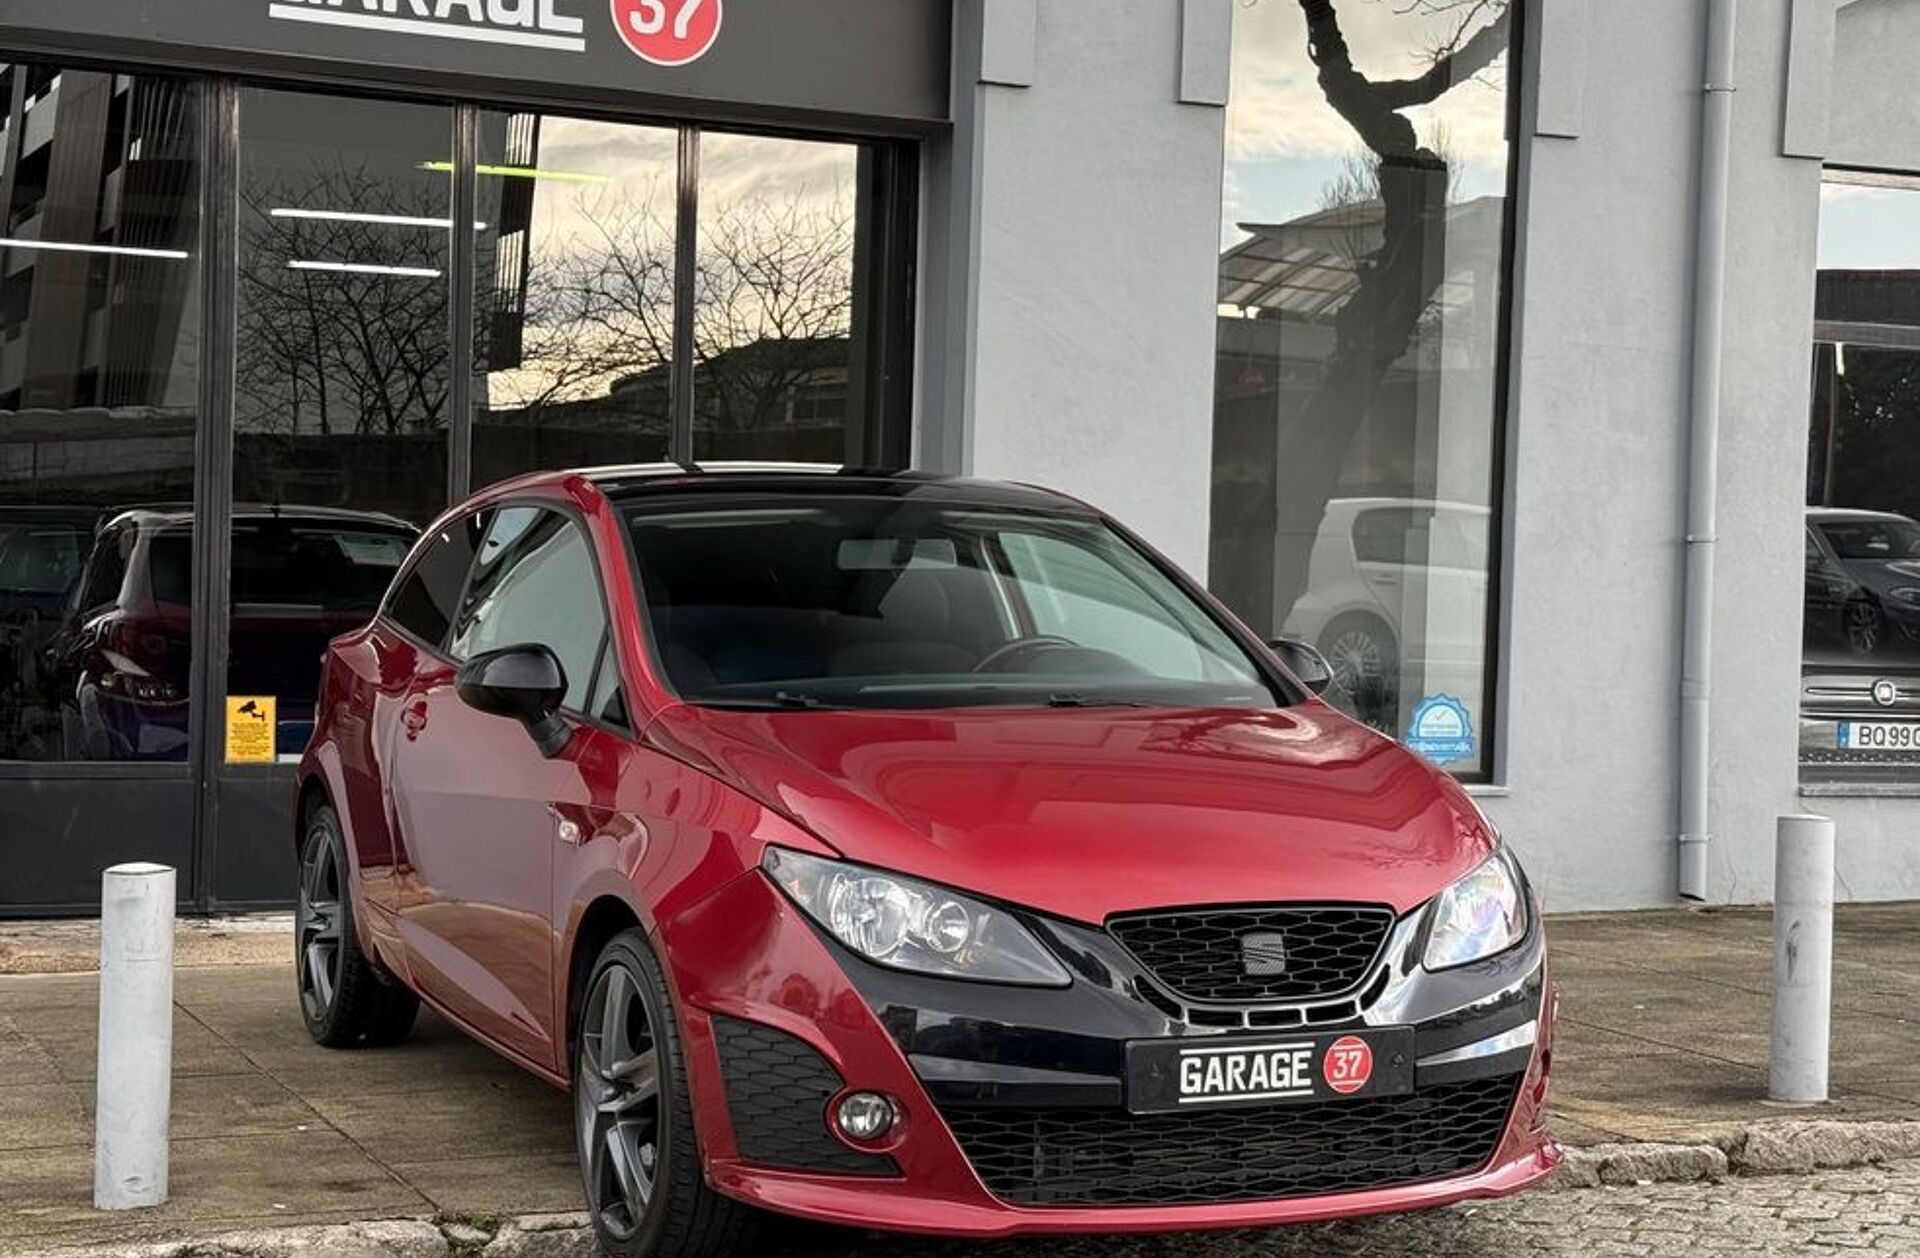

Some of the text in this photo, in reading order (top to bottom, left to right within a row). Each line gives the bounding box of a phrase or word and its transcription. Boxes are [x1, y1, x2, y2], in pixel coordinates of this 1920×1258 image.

[1889, 726, 1910, 746] 99
[1180, 1050, 1362, 1094] GARAGE 37
